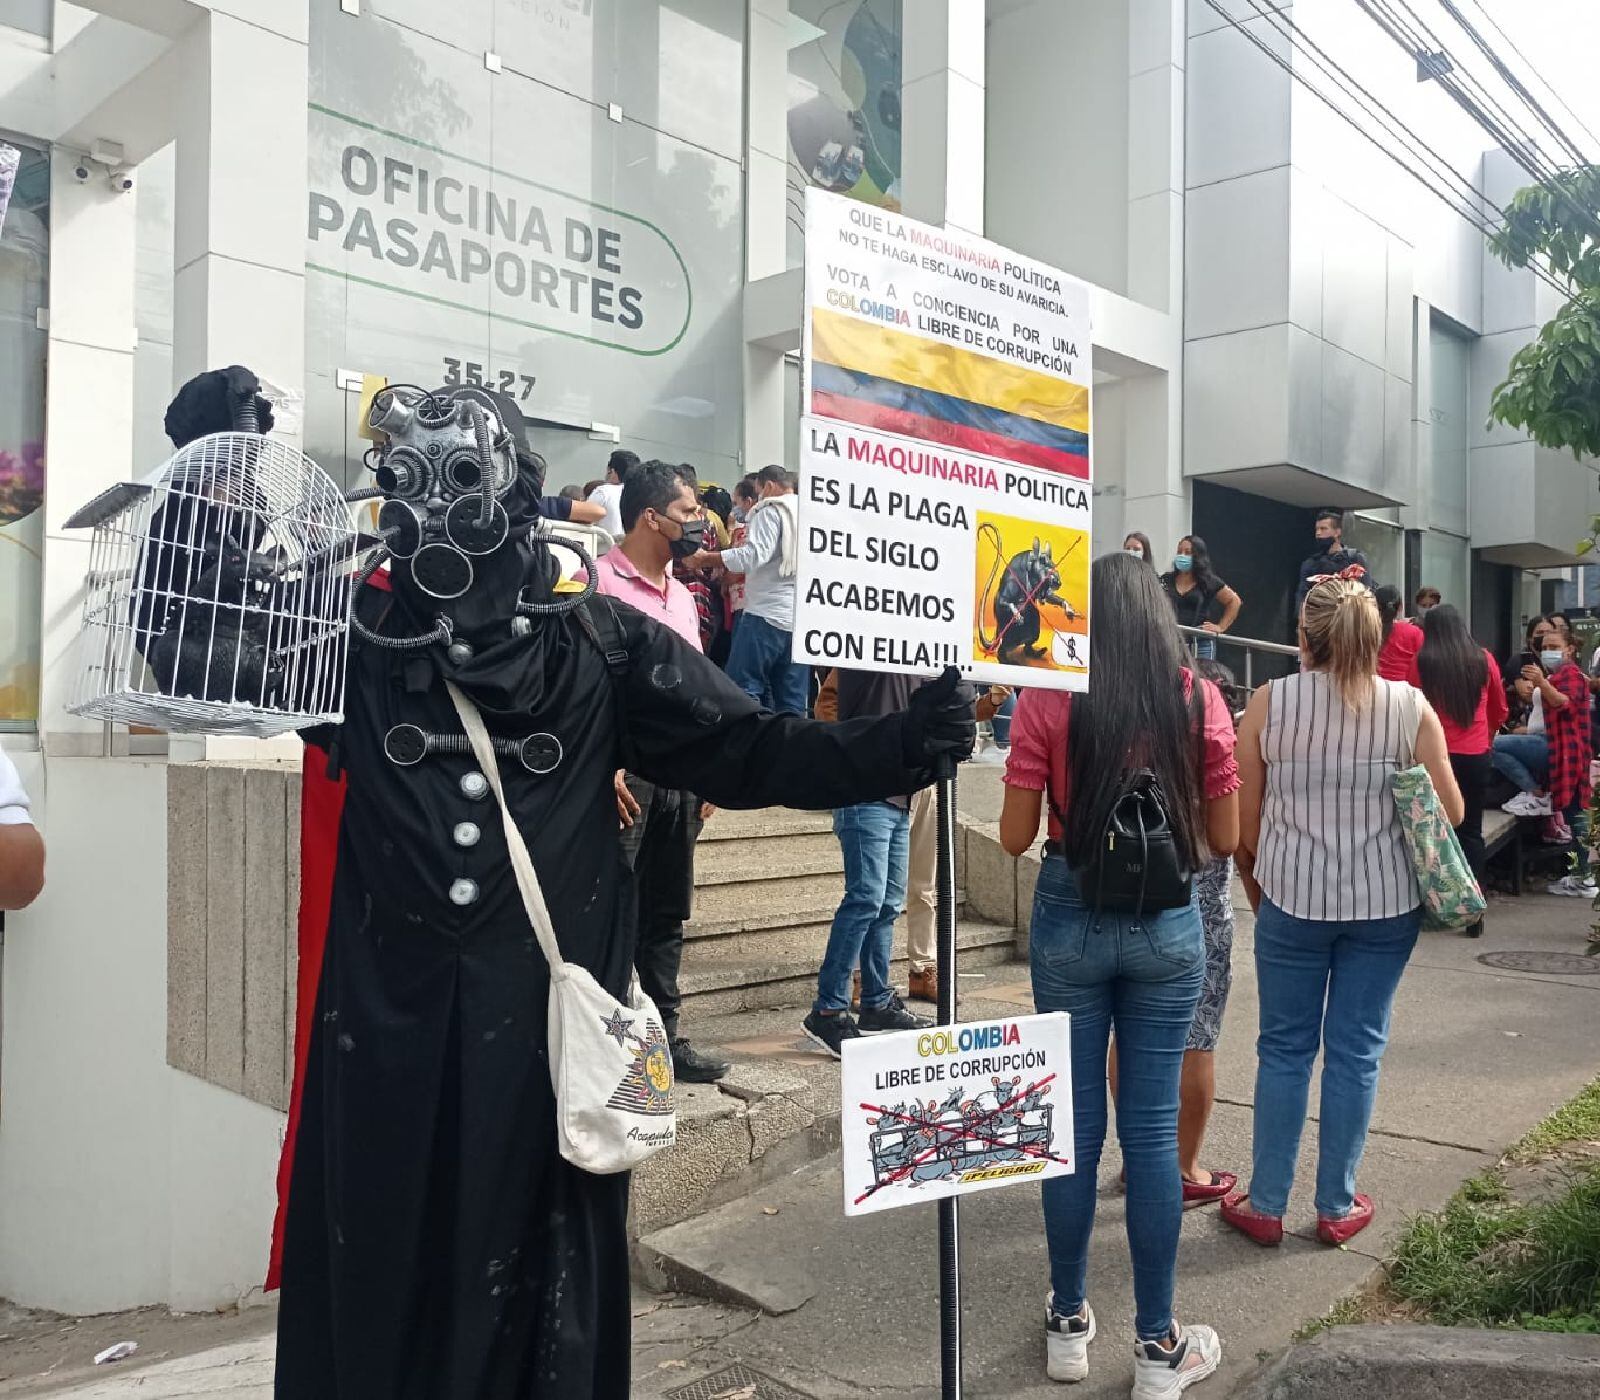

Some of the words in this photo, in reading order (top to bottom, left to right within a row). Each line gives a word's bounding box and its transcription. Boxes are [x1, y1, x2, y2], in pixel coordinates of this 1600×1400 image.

[341, 144, 552, 254] OFICINA
[565, 216, 621, 274] DE
[308, 192, 644, 330] PASAPORTES
[839, 228, 859, 246] NO
[863, 236, 878, 253] TE
[882, 243, 918, 266] HAGA
[922, 257, 977, 285] ESCLAVO
[981, 276, 997, 291] DE
[999, 282, 1014, 299] SU
[1016, 288, 1069, 317] AVARICIA.
[850, 208, 882, 232] QUE
[887, 221, 907, 241] LA
[910, 228, 1001, 273] MAQUINARIA
[1004, 262, 1061, 295] POLÍTICA
[826, 265, 870, 291] VOTA
[886, 283, 898, 301] A
[913, 292, 1000, 331] CONCIENCIA
[1013, 323, 1040, 344] POR
[1053, 336, 1079, 358] UNA
[826, 288, 910, 327] COLOMBIA
[918, 315, 960, 340] LIBRE
[965, 329, 983, 347] DE
[986, 337, 1072, 376] CORRUPCIÓN
[444, 357, 536, 400] 35-27
[810, 475, 840, 505] ES
[849, 483, 880, 514] LA
[888, 491, 969, 530] PLAGA
[811, 429, 840, 457] LA
[848, 437, 999, 490] MAQUINARIA
[1005, 473, 1089, 511] POLITICA
[809, 528, 858, 558] DEL
[866, 536, 939, 571] SIGLO
[806, 578, 955, 622] ACABEMOS
[805, 629, 864, 660] CON
[876, 1068, 920, 1090] LIBRE
[925, 1065, 945, 1082] DE
[950, 1048, 1046, 1079] CORRUPCIÓN
[917, 1024, 1021, 1056] COLOMBIA
